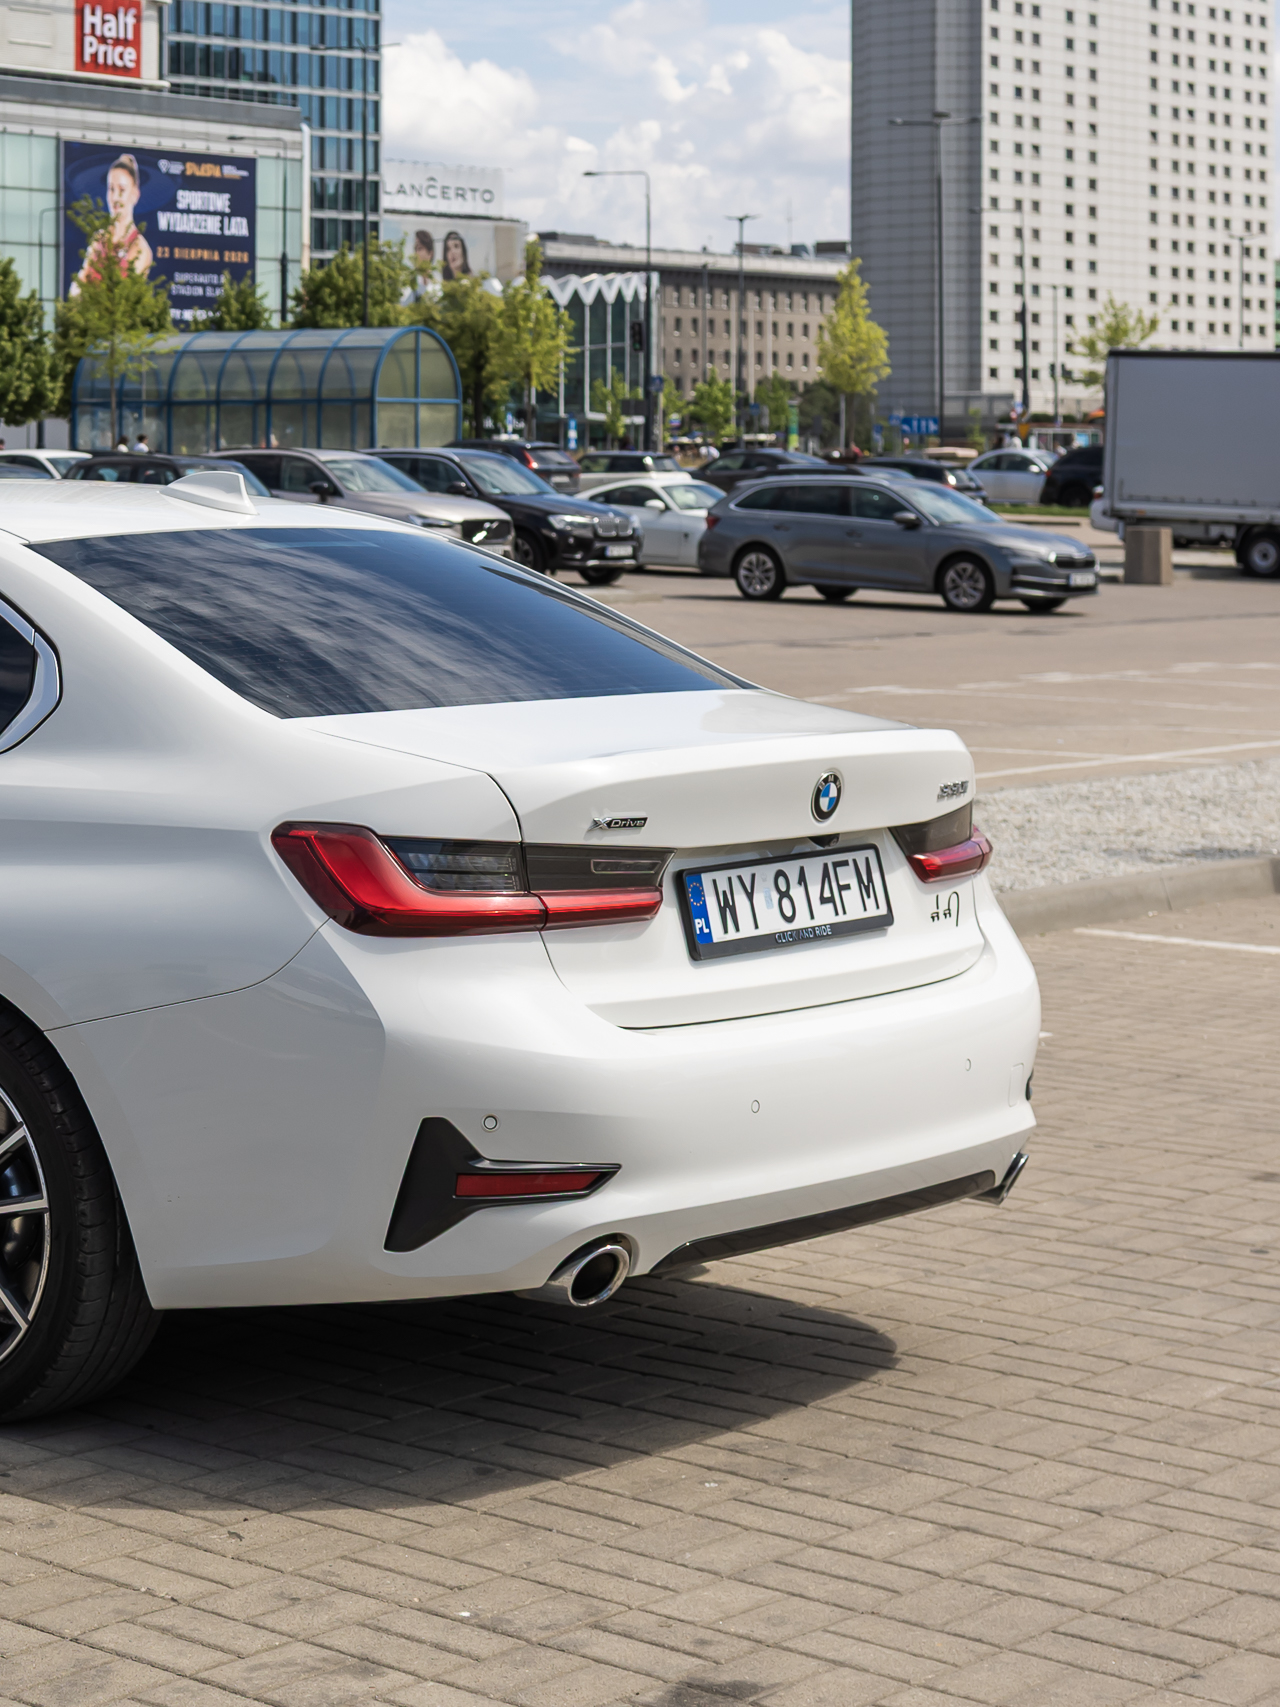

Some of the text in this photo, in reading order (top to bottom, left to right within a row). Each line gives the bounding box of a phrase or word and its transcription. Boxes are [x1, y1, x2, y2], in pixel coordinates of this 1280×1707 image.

[83, 3, 136, 40] Half
[83, 35, 137, 68] Price
[223, 216, 249, 236] LATA
[712, 856, 880, 934] WY 814FM
[694, 917, 710, 934] PL
[775, 924, 832, 942] CLICK AND RIDE
